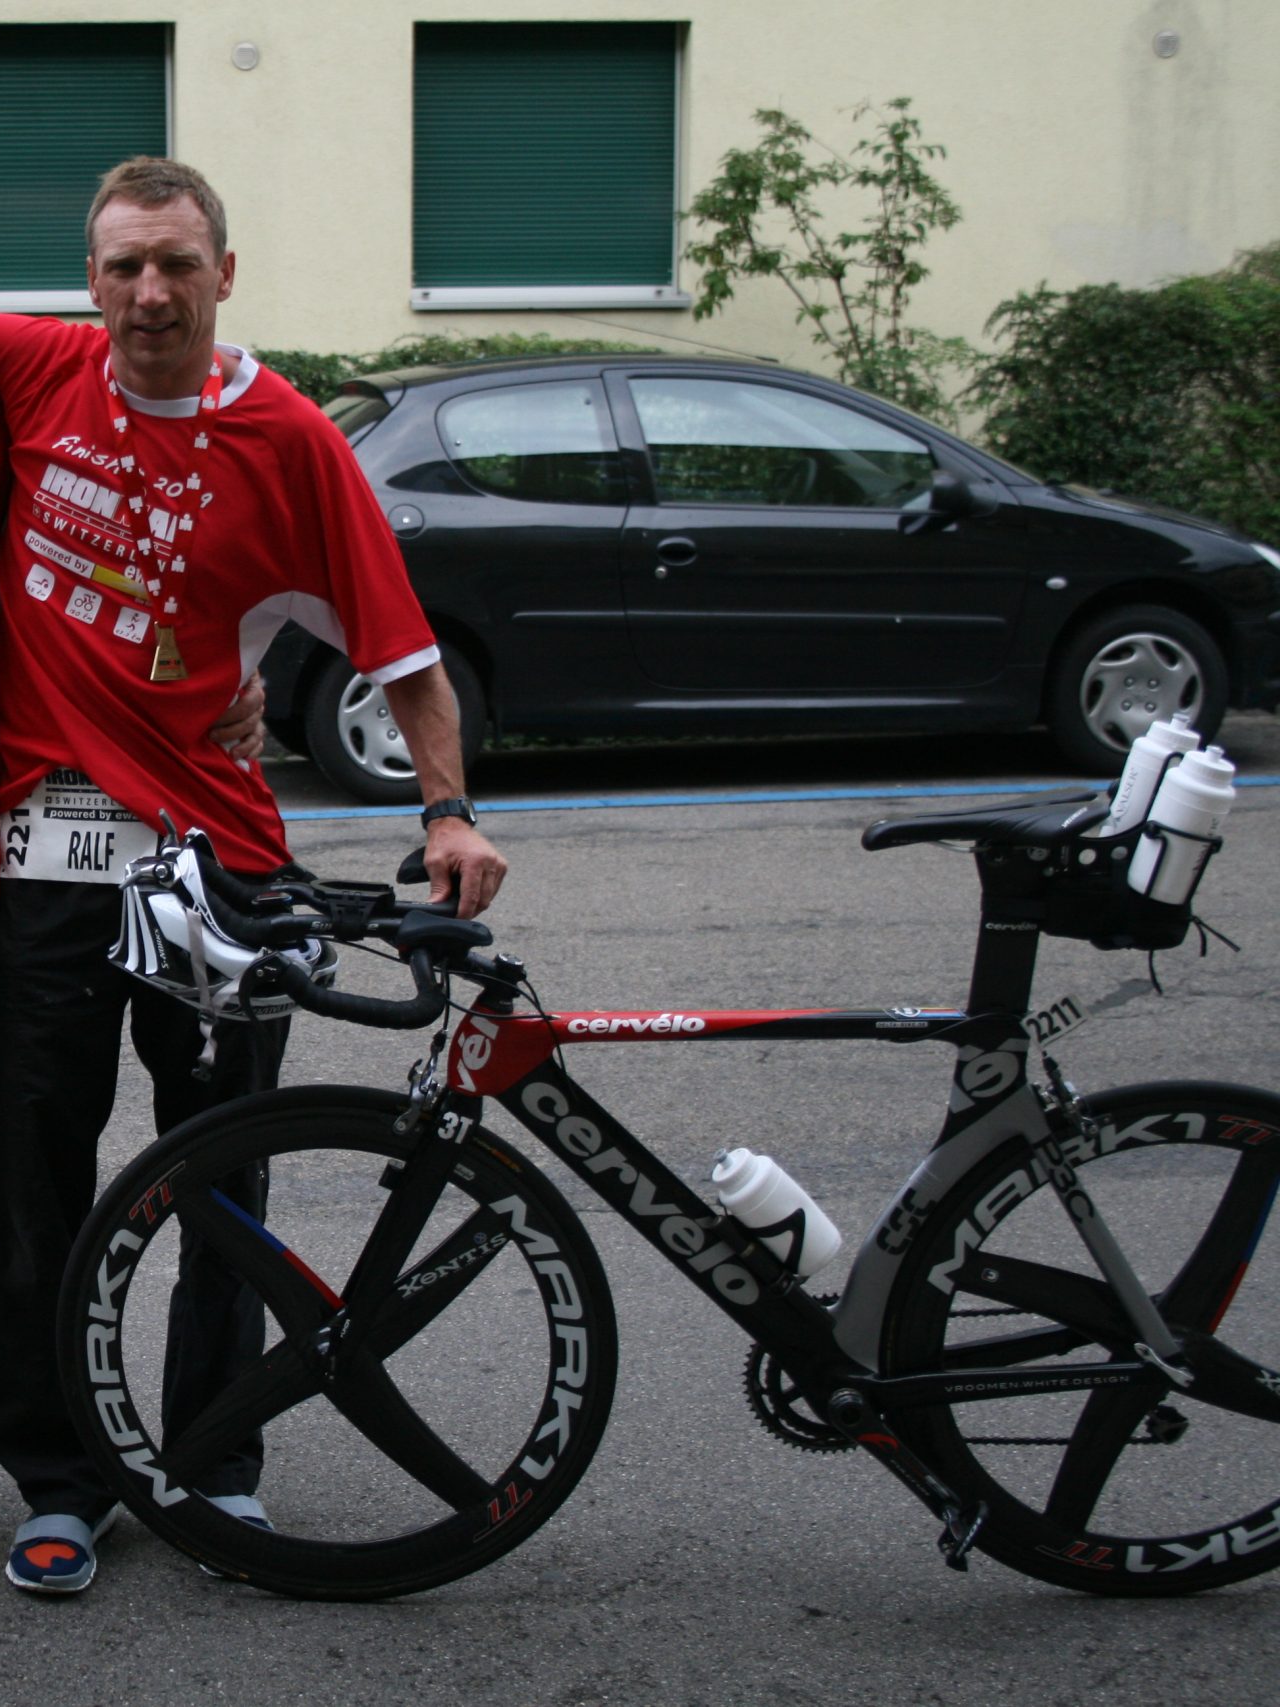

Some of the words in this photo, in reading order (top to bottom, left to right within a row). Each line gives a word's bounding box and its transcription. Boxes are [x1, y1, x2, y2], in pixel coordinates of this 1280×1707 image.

[153, 477, 213, 509] 209
[28, 535, 72, 565] powered
[74, 556, 89, 574] by
[6, 792, 31, 866] 221
[49, 809, 96, 820] powered
[98, 811, 111, 821] by
[67, 830, 115, 872] RALF
[568, 1013, 705, 1034] cervélo
[1025, 997, 1082, 1044] 2211
[437, 1111, 473, 1145] 3T
[521, 1082, 760, 1306] cervélo
[489, 1194, 588, 1481] MARK1
[86, 1228, 190, 1508] MARK1
